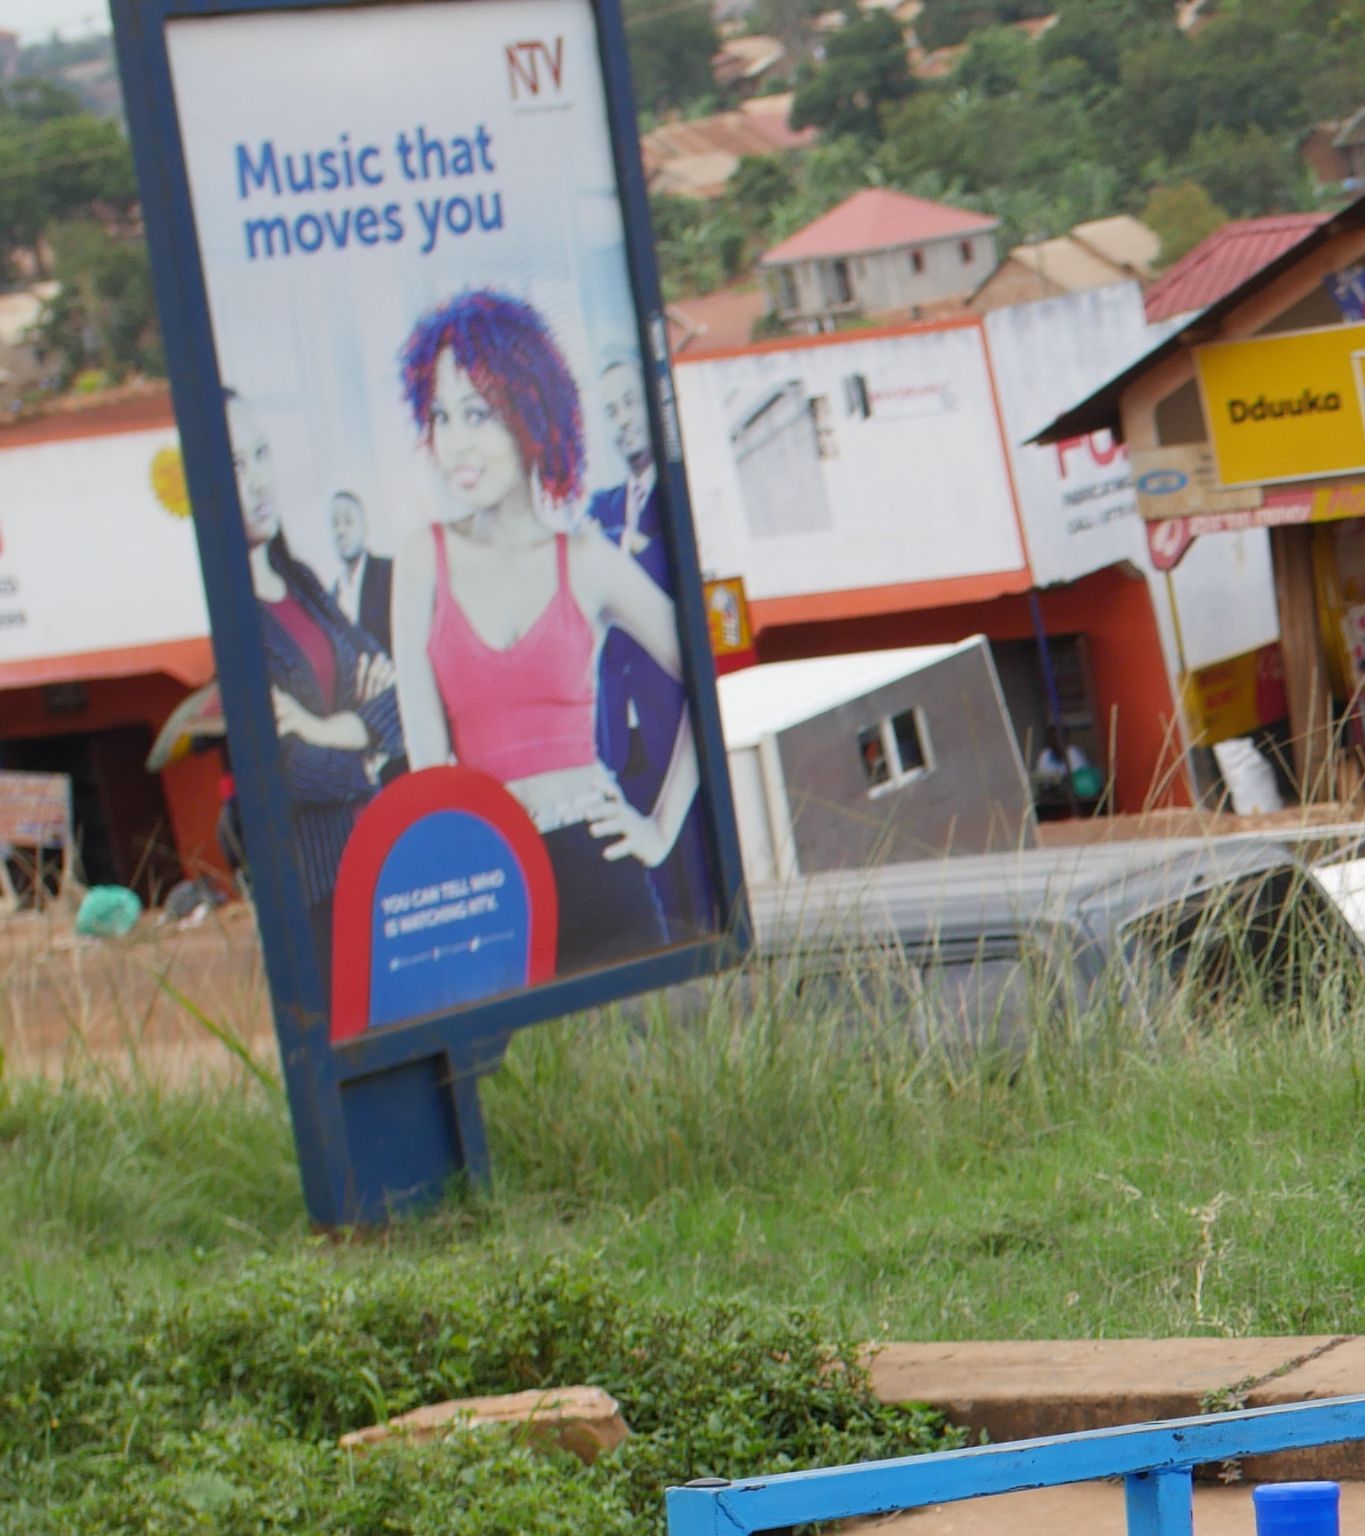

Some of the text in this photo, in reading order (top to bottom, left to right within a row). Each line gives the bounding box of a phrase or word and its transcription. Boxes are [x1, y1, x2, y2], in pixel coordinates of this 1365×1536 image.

[505, 34, 565, 100] NTV
[234, 123, 496, 200] Music that
[243, 191, 506, 261] moves you
[1227, 388, 1342, 425] Dduuka
